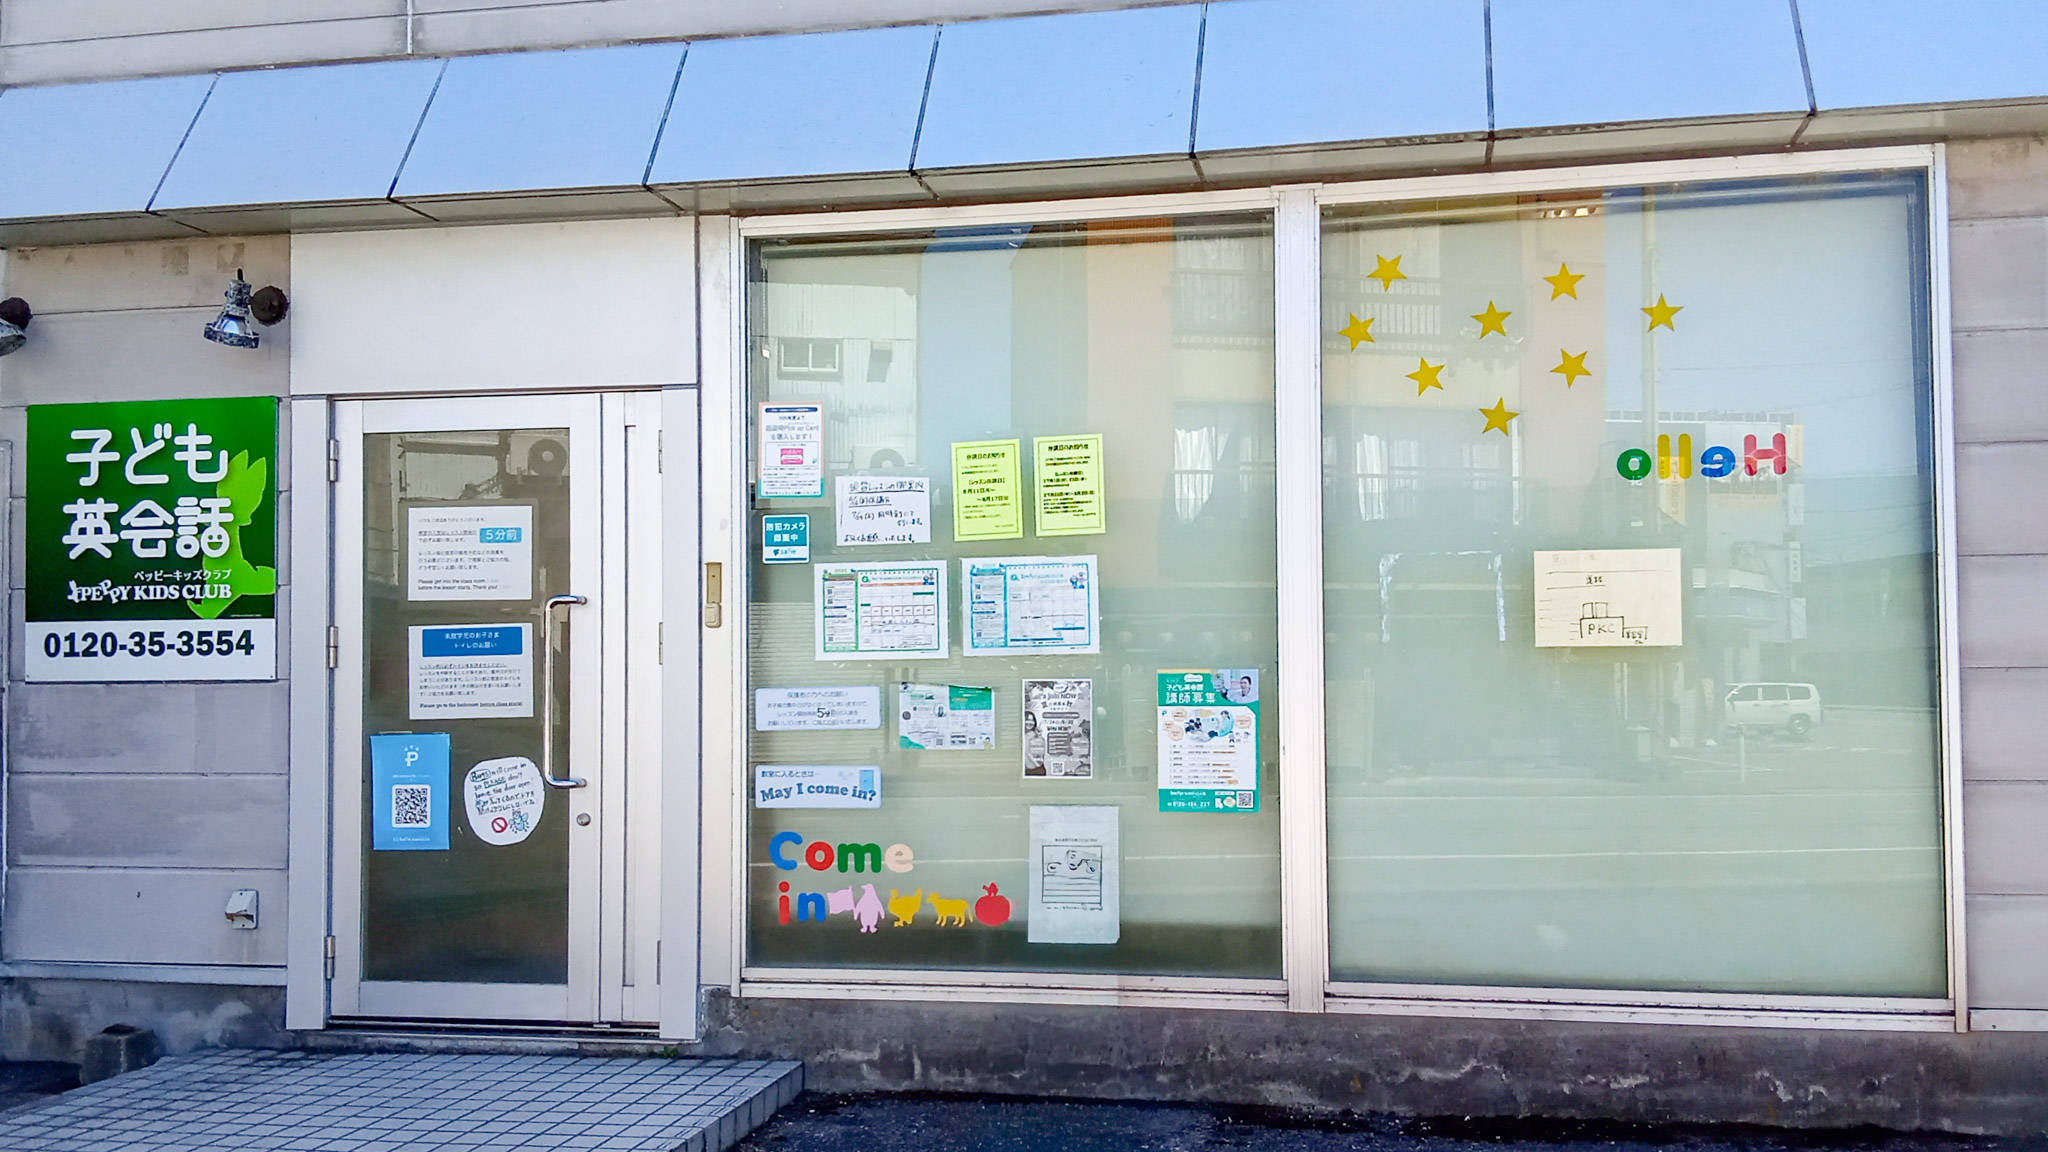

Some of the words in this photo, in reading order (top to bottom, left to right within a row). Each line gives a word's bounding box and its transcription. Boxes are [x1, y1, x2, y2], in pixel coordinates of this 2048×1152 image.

[66, 423, 229, 487] 子ども
[62, 496, 235, 560] 英会話
[486, 529, 517, 541] 5分前
[765, 522, 806, 532] 防犯カメラ
[78, 579, 132, 605] PEPPY
[133, 584, 180, 601] KIDS
[182, 583, 232, 600] CLUB
[44, 629, 255, 658] 0120-35-3554
[1166, 691, 1217, 705] 講師募集
[760, 783, 793, 802] May
[796, 782, 804, 795] I
[807, 784, 848, 796] come
[852, 785, 877, 801] in?
[769, 831, 914, 873] Come
[778, 881, 826, 925] in
